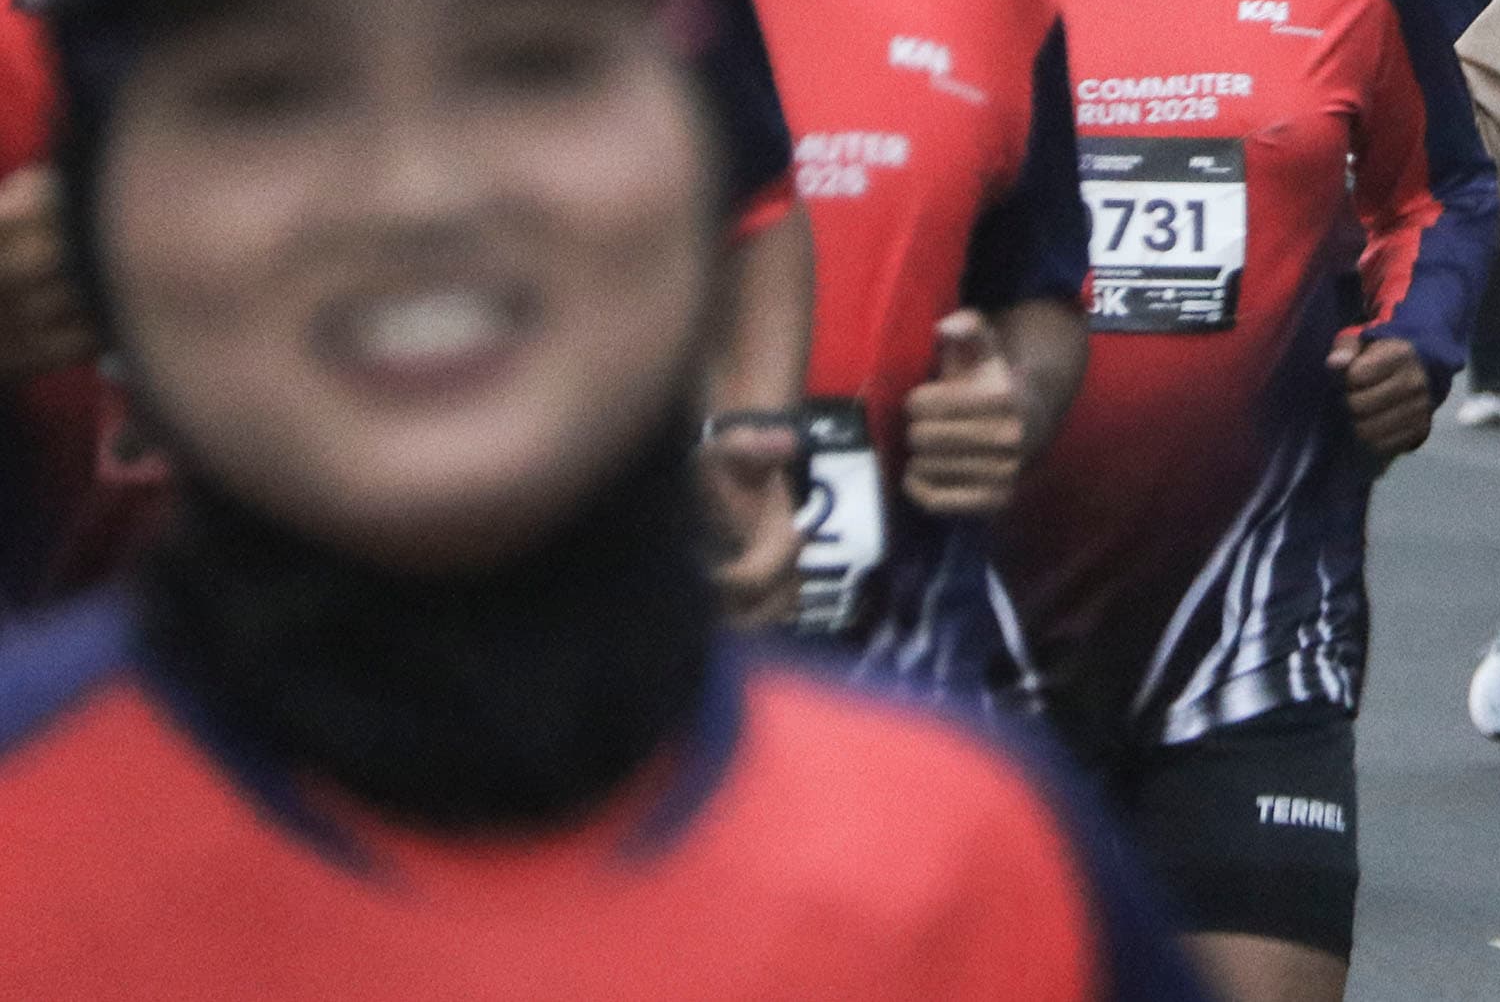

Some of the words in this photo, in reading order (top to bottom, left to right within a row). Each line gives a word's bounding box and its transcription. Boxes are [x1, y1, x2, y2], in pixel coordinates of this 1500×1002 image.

[1076, 73, 1253, 101] COMMUTER
[1076, 101, 1141, 125] RUN
[1082, 199, 1205, 253] 731
